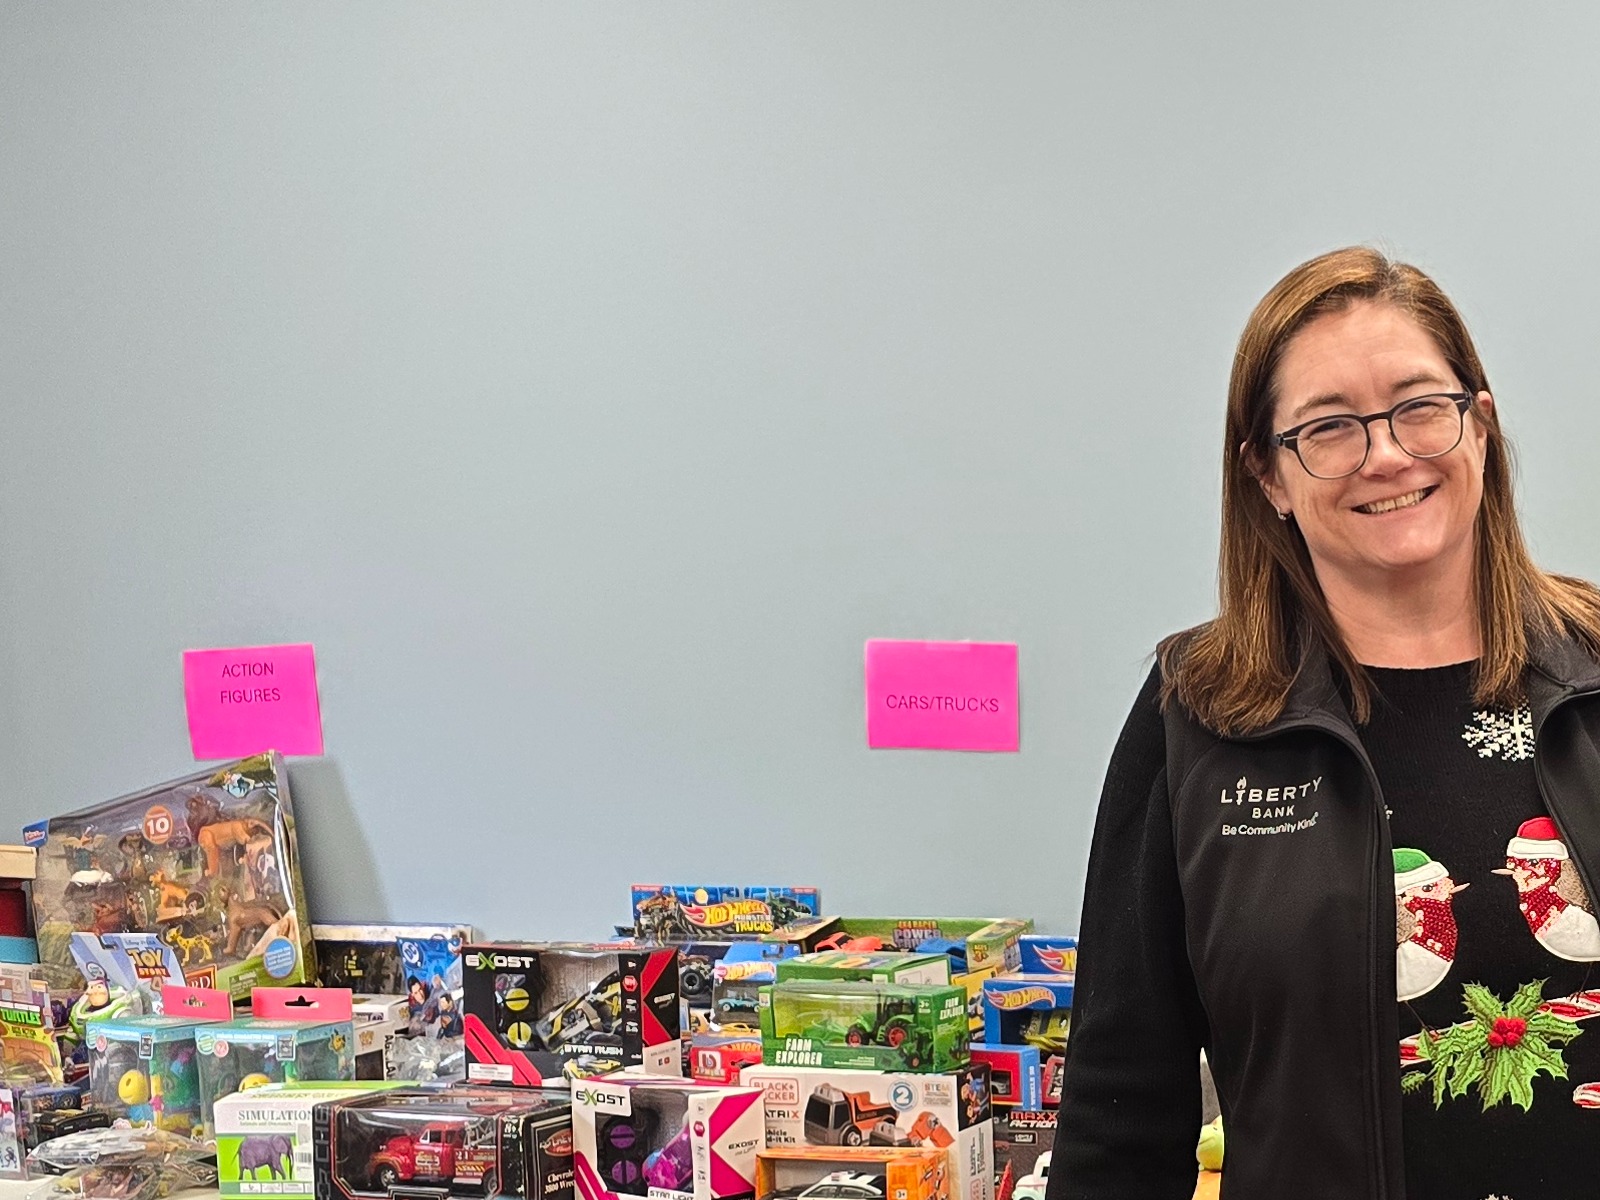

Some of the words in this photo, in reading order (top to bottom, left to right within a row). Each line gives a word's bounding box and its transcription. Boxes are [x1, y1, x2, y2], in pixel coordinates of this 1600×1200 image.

[221, 662, 274, 678] ACTION
[220, 687, 281, 704] FIGURES
[886, 694, 999, 713] CARS/TRUCKS
[1220, 776, 1323, 805] LIBERTY
[1251, 805, 1295, 819] BANK
[146, 817, 170, 835] 10
[1221, 824, 1237, 836] Be
[1238, 822, 1296, 836] Community
[705, 905, 728, 925] HOT
[734, 920, 773, 933] TRUCKS
[129, 948, 164, 970] TOY
[403, 944, 418, 961] DC
[465, 952, 534, 970] EXOST
[1, 1008, 41, 1026] TURTLES
[785, 1038, 812, 1051] FARM
[775, 1050, 823, 1065] EXPLORER
[575, 1088, 626, 1106] EXOST
[765, 1091, 795, 1101] CKER
[895, 1087, 908, 1104] 2
[765, 1109, 800, 1119] ATRIX
[1008, 1119, 1058, 1129] ACTION
[728, 1139, 760, 1150] EXOST
[547, 1169, 575, 1183] Chevrole
[649, 1190, 671, 1200] STAR
